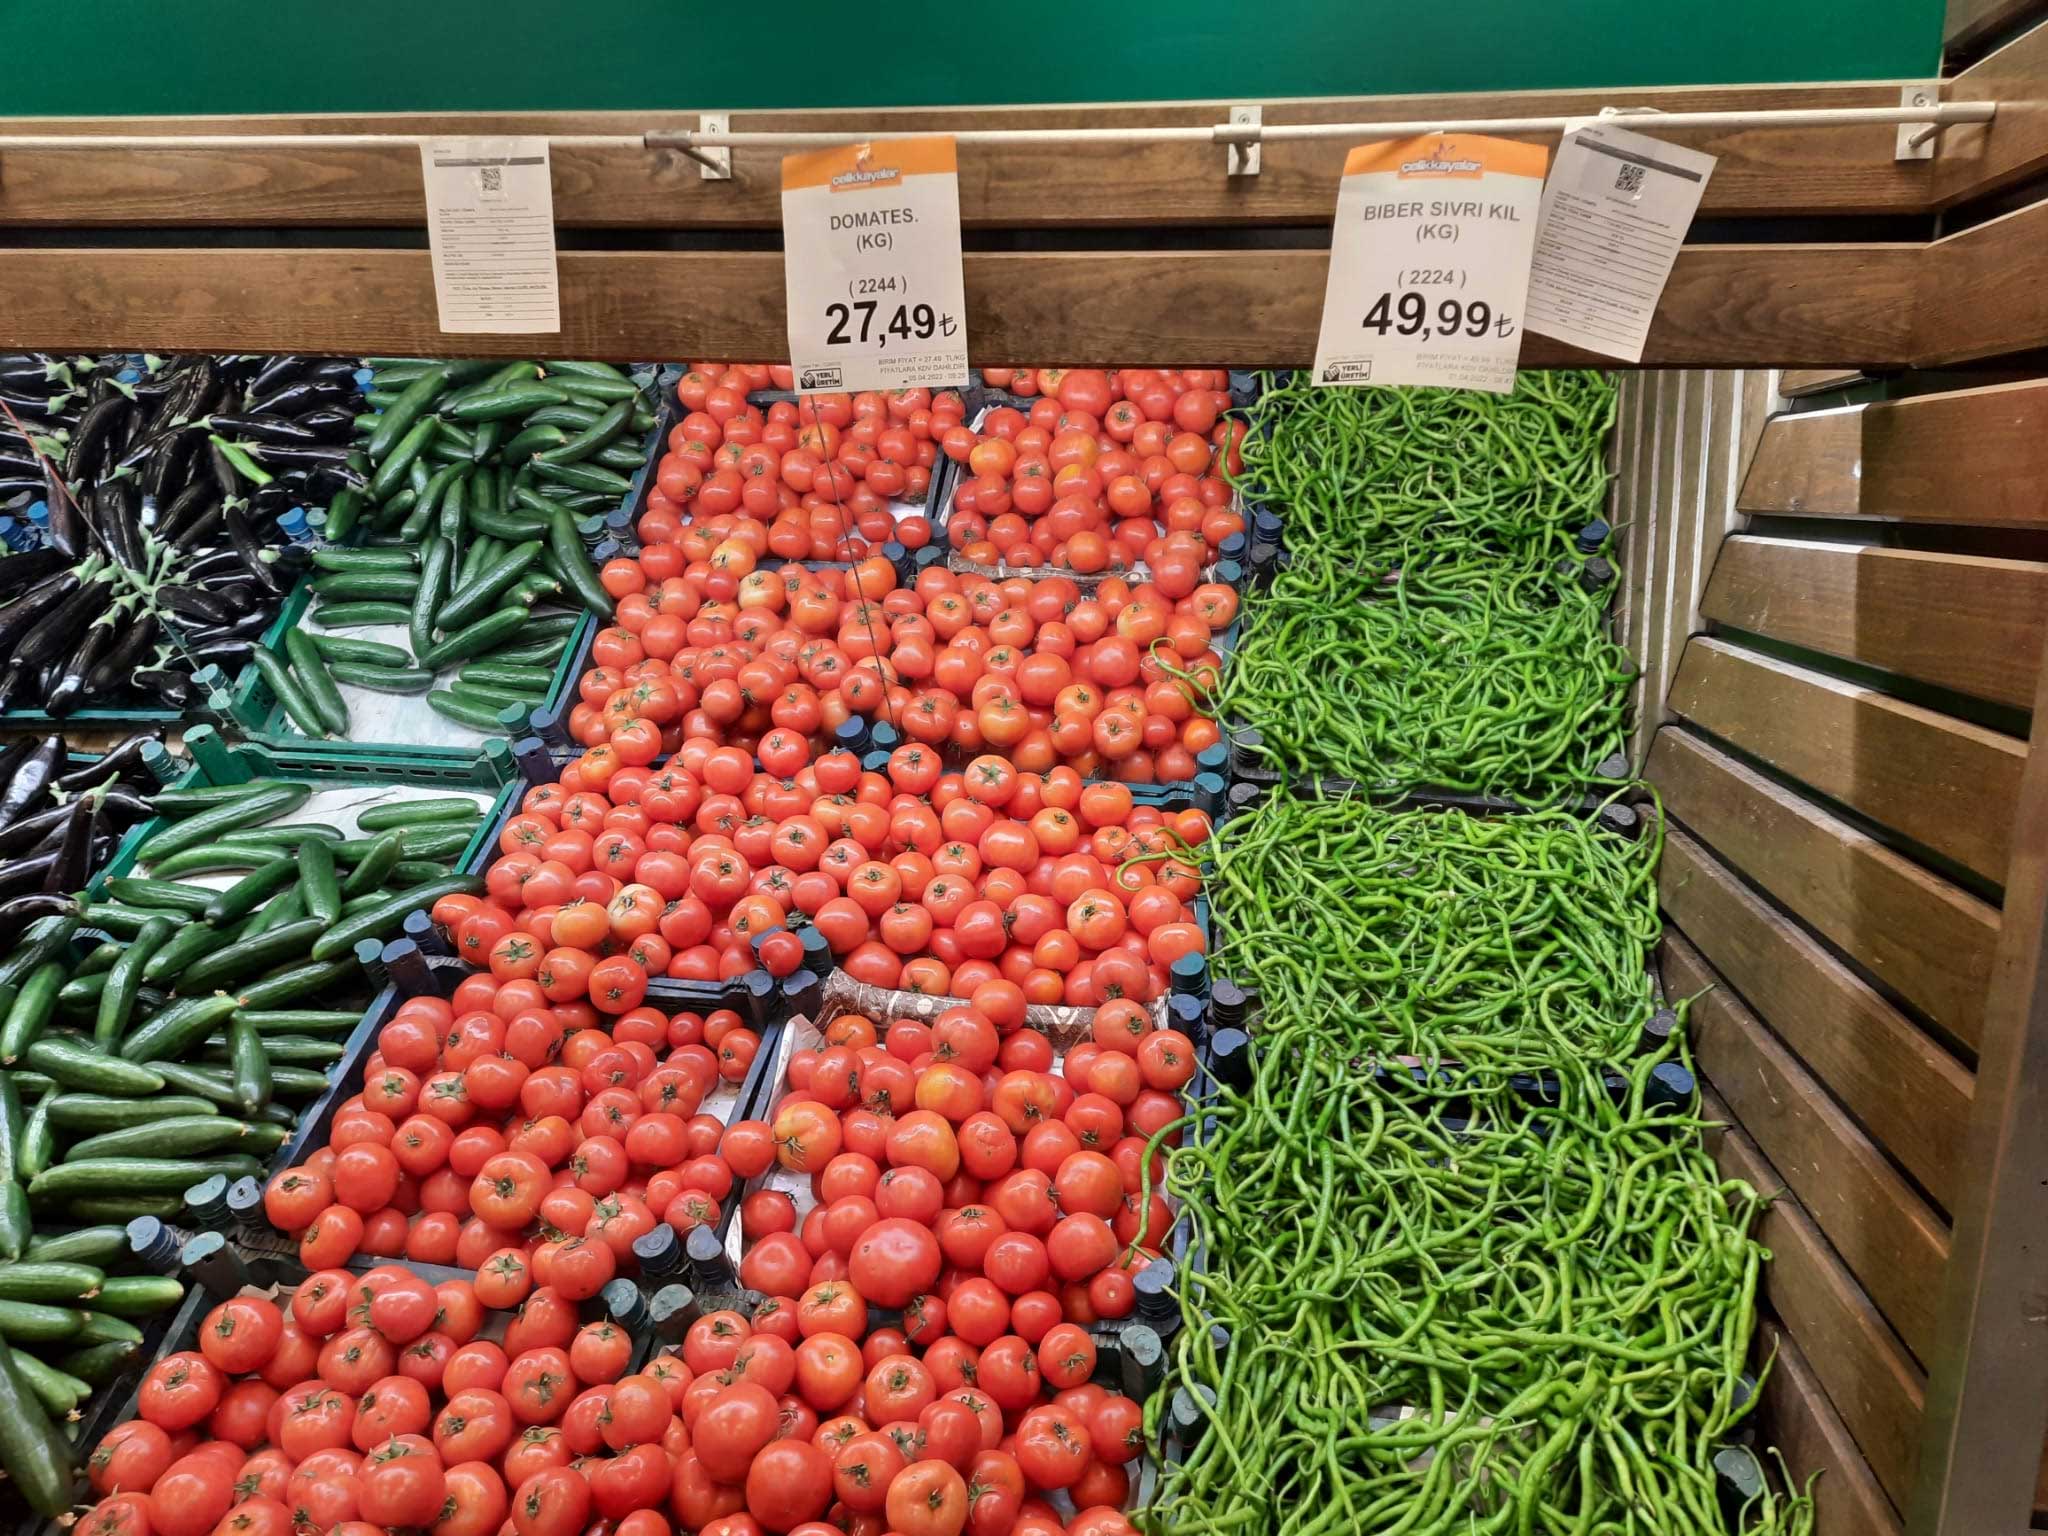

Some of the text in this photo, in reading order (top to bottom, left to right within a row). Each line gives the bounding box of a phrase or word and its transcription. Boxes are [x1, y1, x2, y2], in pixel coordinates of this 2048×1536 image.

[829, 207, 919, 231] DOMATES.
[1363, 201, 1521, 221] BIBER SIVRI KIL
[856, 231, 894, 253] (KG)
[1415, 223, 1460, 243] (KG)
